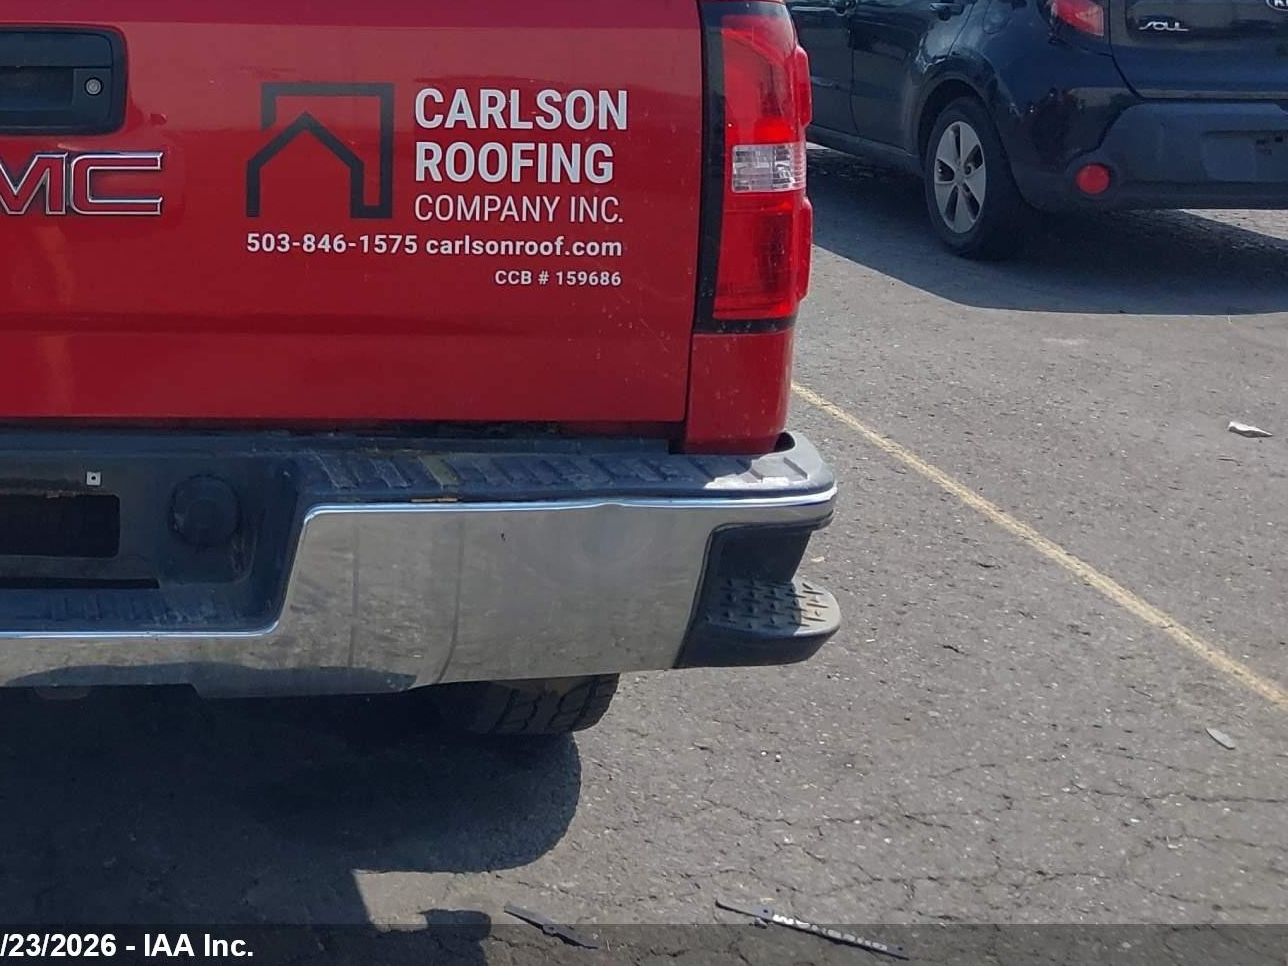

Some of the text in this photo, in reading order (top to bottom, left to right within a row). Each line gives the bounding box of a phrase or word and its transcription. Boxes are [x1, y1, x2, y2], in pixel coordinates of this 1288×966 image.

[1139, 21, 1189, 31] SOUL
[415, 88, 628, 131] CARLSON
[415, 141, 614, 184] ROOFING
[415, 194, 624, 223] COMPANY INC.
[246, 233, 623, 257] 503-846-1575 carlsonroof.com
[495, 270, 622, 286] CCB # 159686
